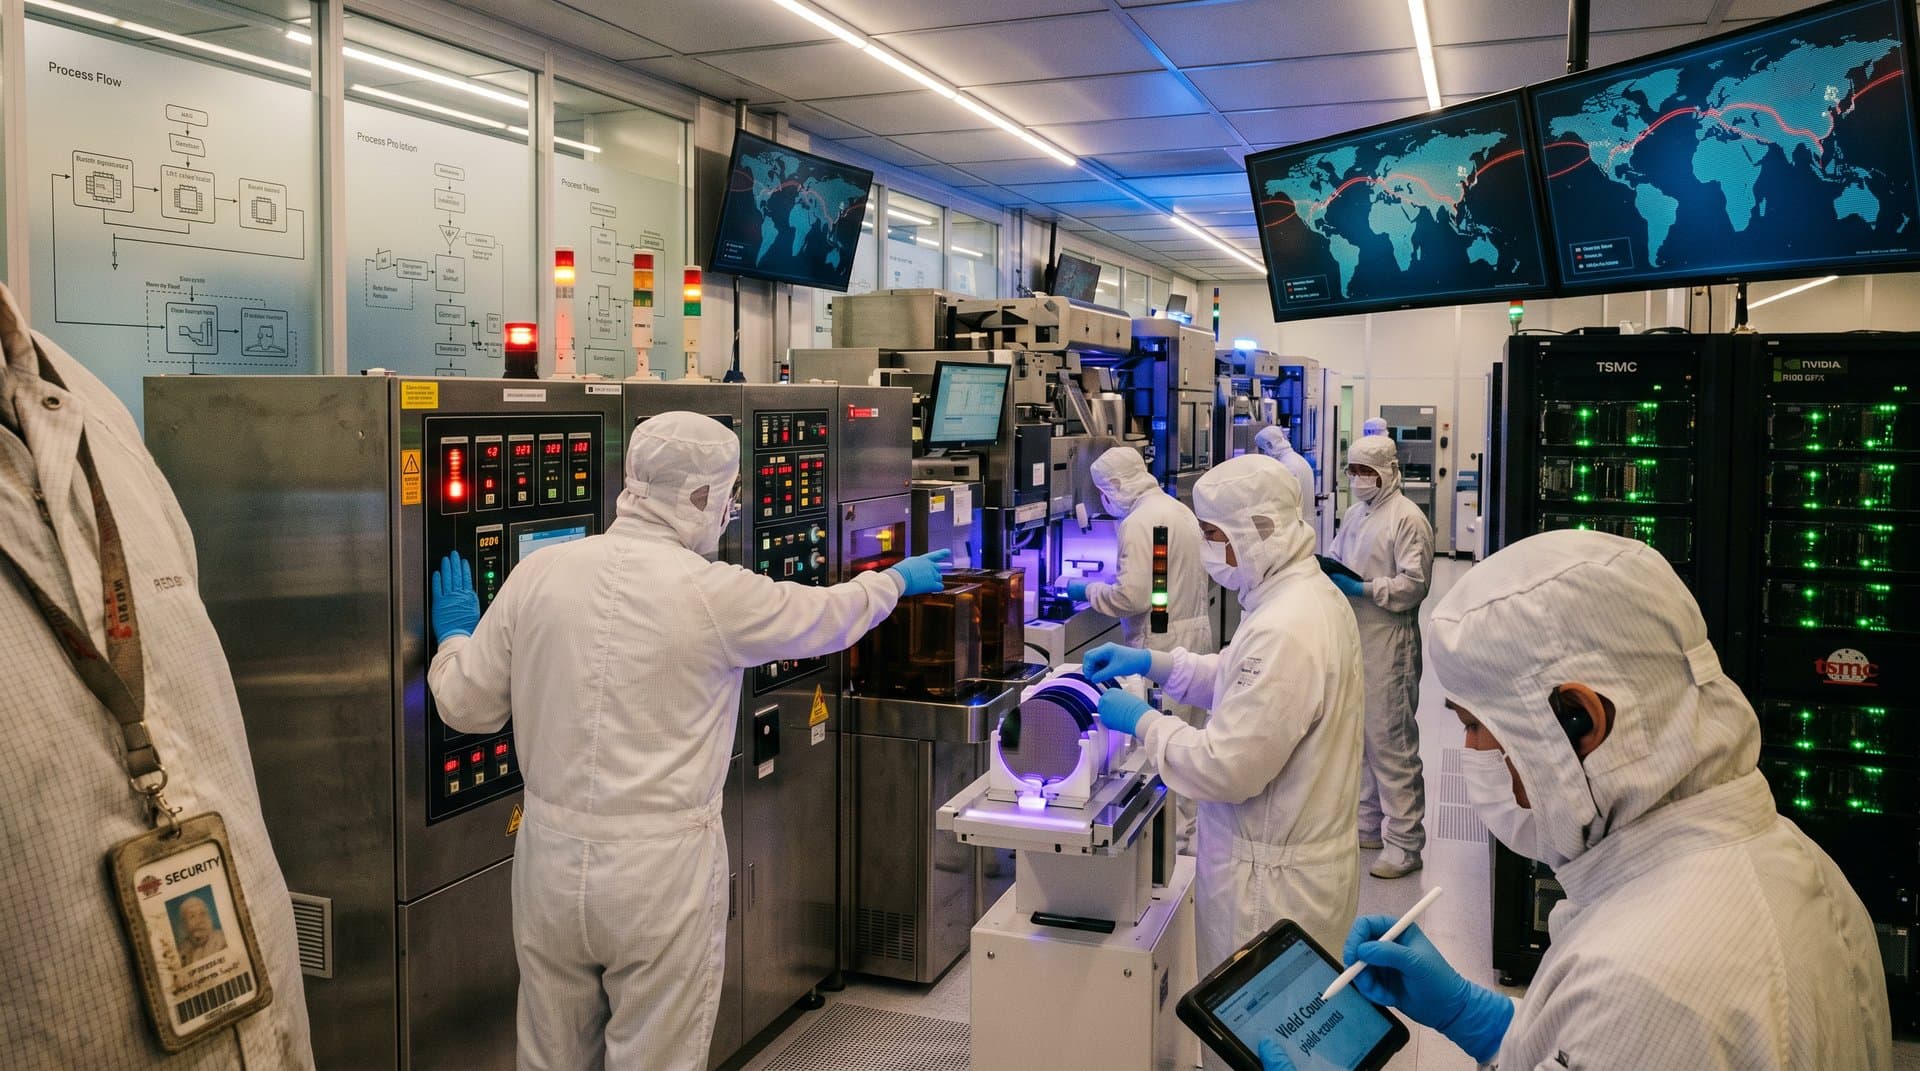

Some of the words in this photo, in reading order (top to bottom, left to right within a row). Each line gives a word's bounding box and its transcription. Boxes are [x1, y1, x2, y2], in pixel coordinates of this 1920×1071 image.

[48, 61, 94, 81] Process
[96, 71, 122, 87] Flow
[357, 131, 386, 146] Process
[1596, 361, 1638, 373] TSMC
[165, 856, 220, 886] SECURITY
[1299, 1029, 1321, 1057] yield
